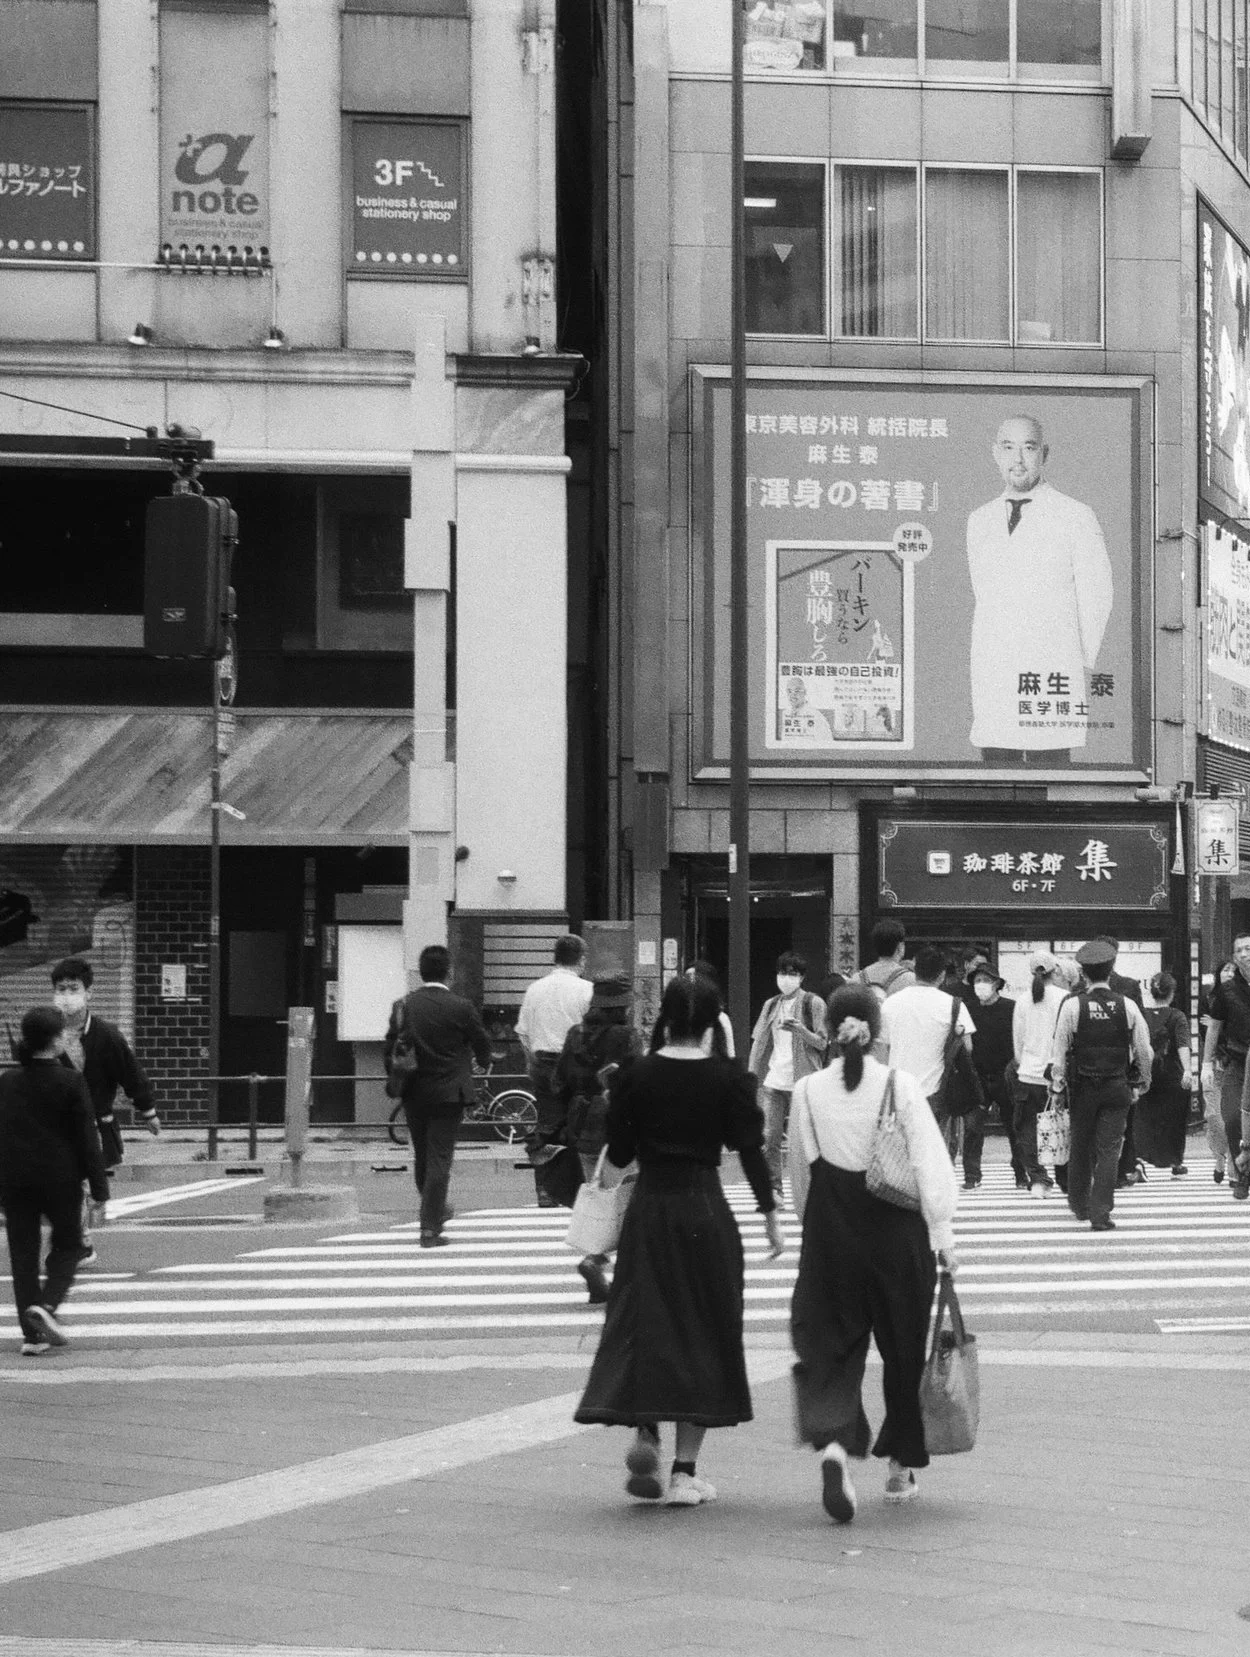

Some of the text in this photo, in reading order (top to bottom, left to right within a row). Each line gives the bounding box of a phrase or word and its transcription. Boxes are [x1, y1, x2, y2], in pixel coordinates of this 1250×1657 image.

[375, 159, 414, 186] 3F
[171, 187, 259, 215] note
[356, 195, 458, 210] business & casual
[362, 208, 451, 222] stationery shop
[867, 416, 949, 438] 統括院長
[902, 529, 922, 539] 好評
[898, 542, 928, 552] 発売中
[851, 556, 872, 632] バーキン
[1018, 672, 1115, 697] 麻生 泰
[1018, 700, 1090, 716] 医学博士
[963, 839, 1118, 882] 珈琲茶館 集
[1205, 839, 1232, 866] 集
